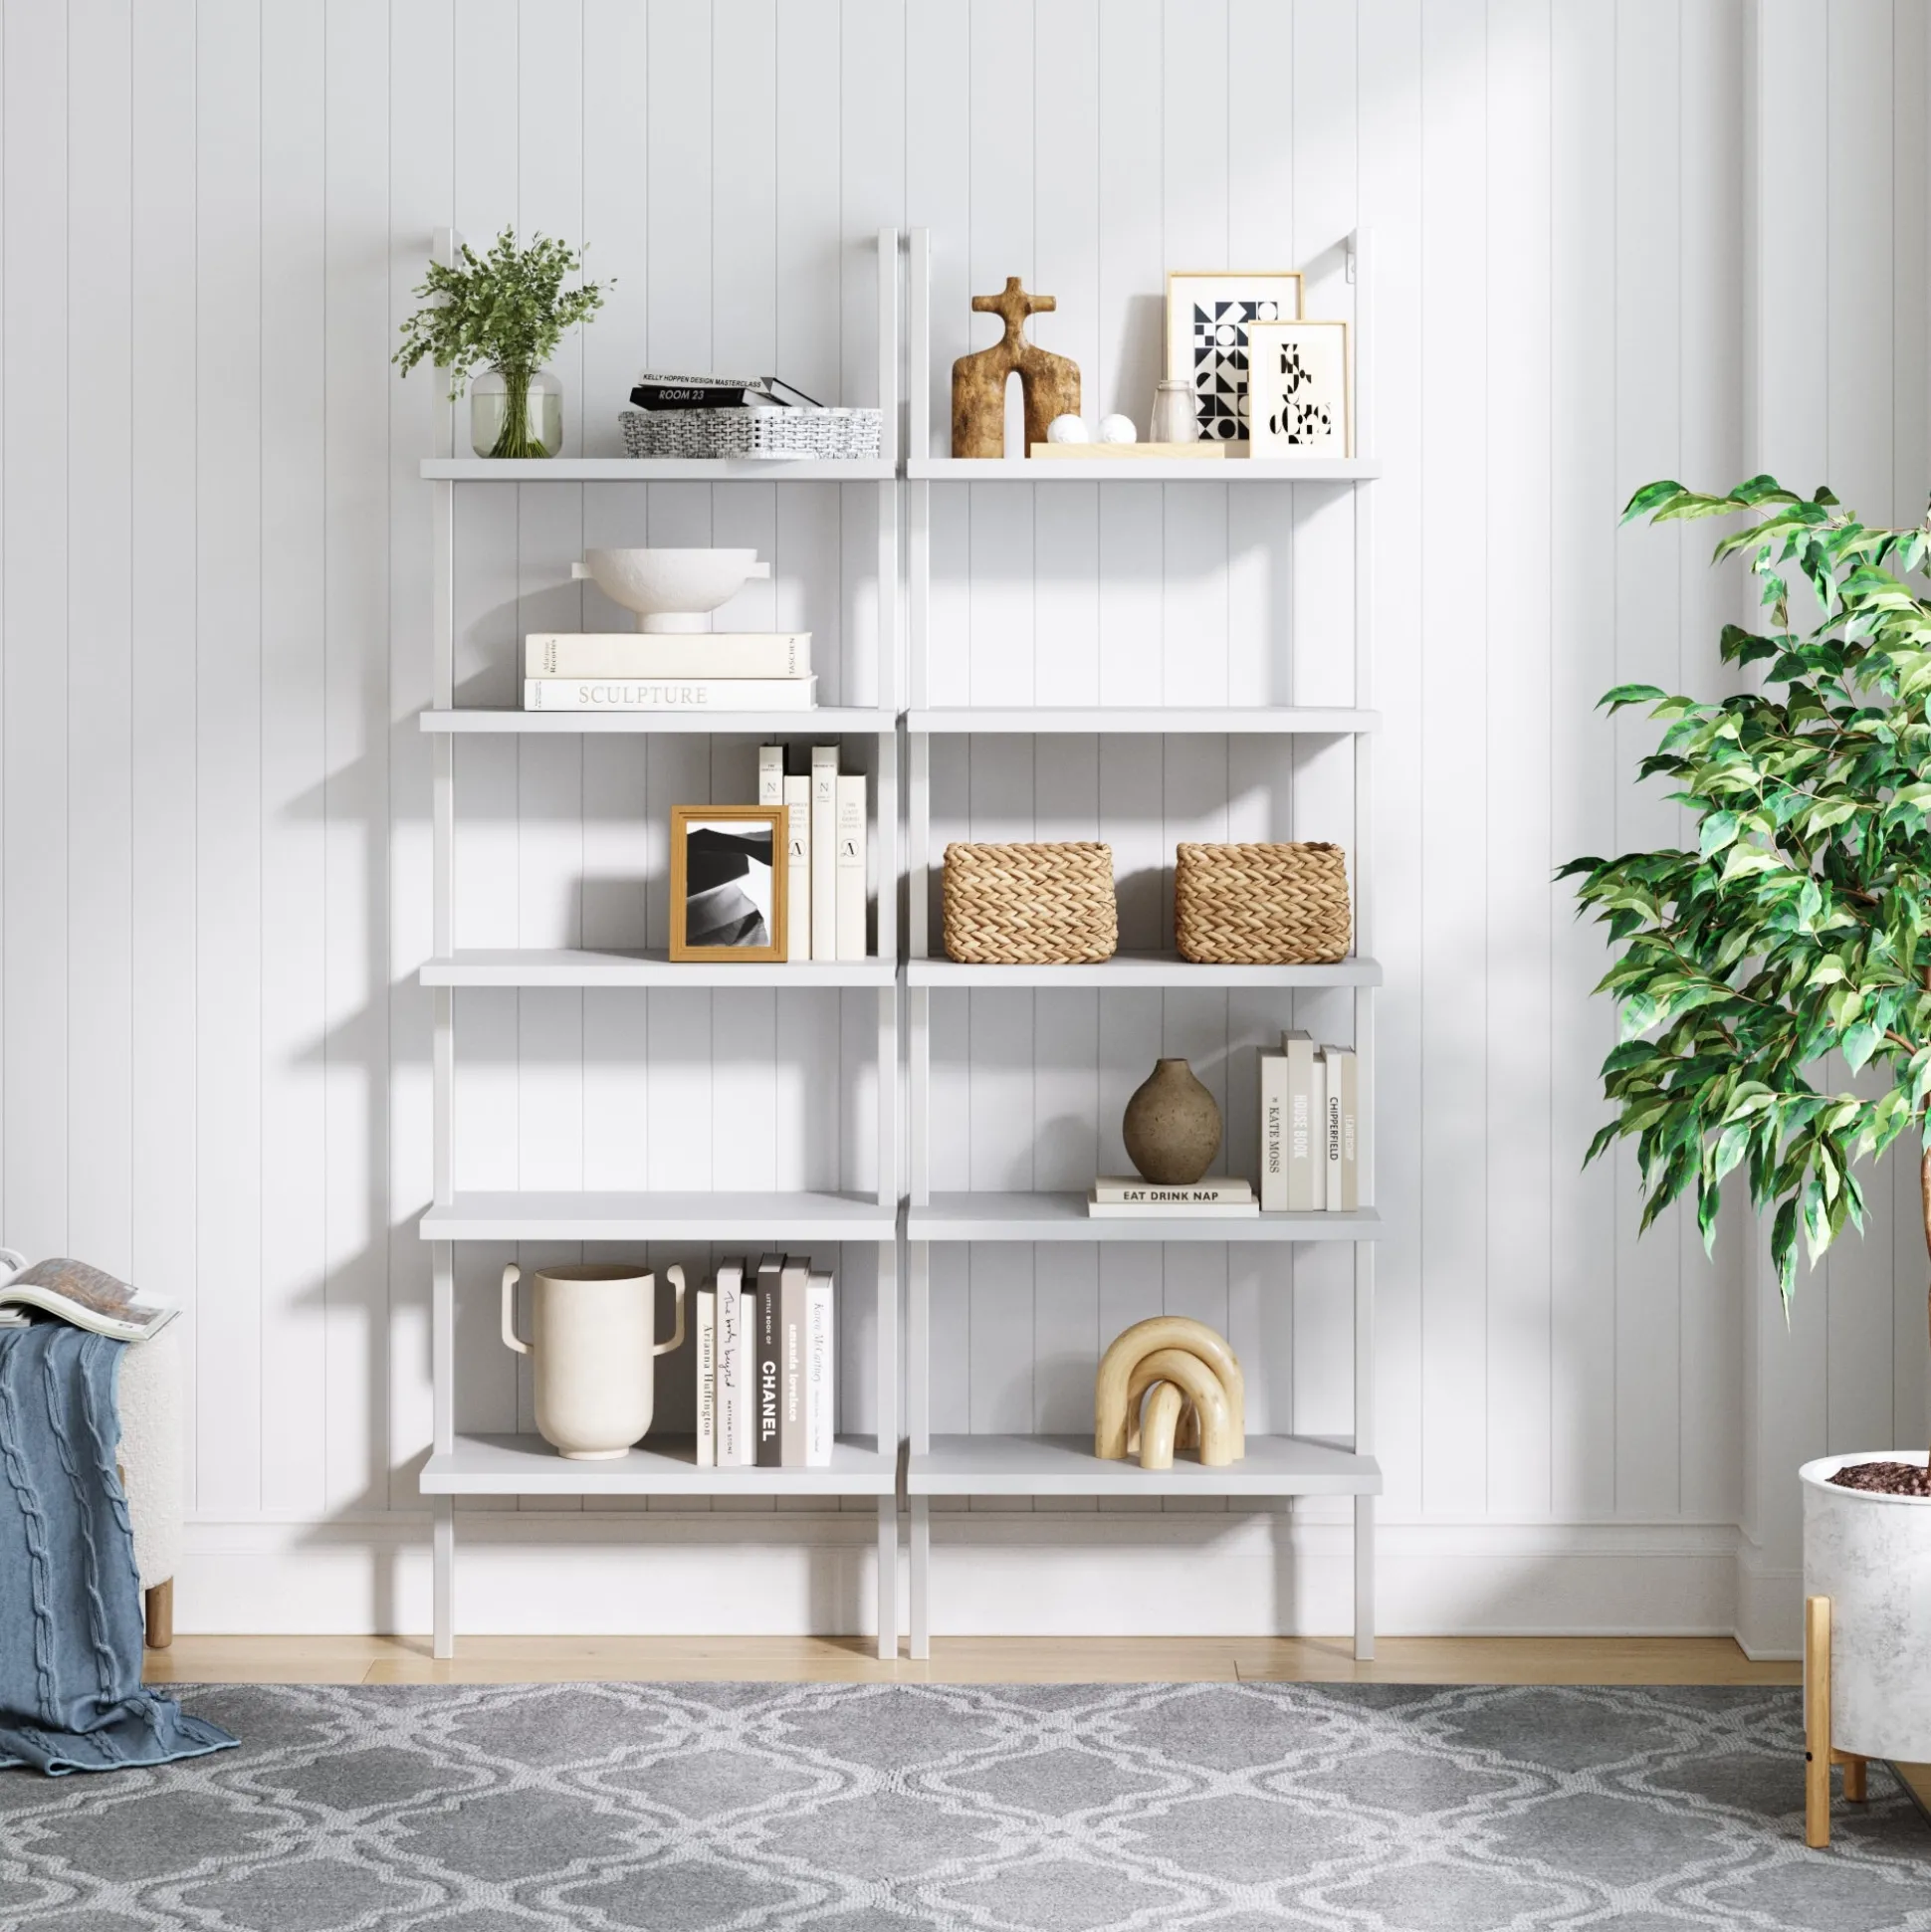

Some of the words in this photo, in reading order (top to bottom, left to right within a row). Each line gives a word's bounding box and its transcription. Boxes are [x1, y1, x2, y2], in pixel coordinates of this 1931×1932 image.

[643, 373, 663, 382] KELLY
[664, 375, 690, 384] HOPPEN
[690, 376, 715, 386] DESIGN
[715, 378, 761, 388] MASTERCLASS
[659, 389, 691, 400] ROOM
[691, 389, 705, 400] 23
[578, 686, 708, 704] SCULPTURE
[819, 781, 829, 792] N
[1269, 1107, 1280, 1138] KATE
[1293, 1095, 1308, 1128] HOUSE
[1330, 1096, 1339, 1161] CHIPPERFIELD
[1269, 1141, 1280, 1174] MOSS
[1293, 1130, 1308, 1159] BOOK
[1123, 1191, 1146, 1201] EAT
[1151, 1191, 1188, 1201] DRINK
[1193, 1191, 1218, 1201] NAP
[724, 1291, 735, 1315] The
[704, 1324, 714, 1369] Arianna
[765, 1335, 771, 1345] OF
[788, 1324, 799, 1370] amanda
[702, 1374, 715, 1435] Huffington
[762, 1361, 776, 1441] CHANEL
[788, 1374, 799, 1421] lovelace
